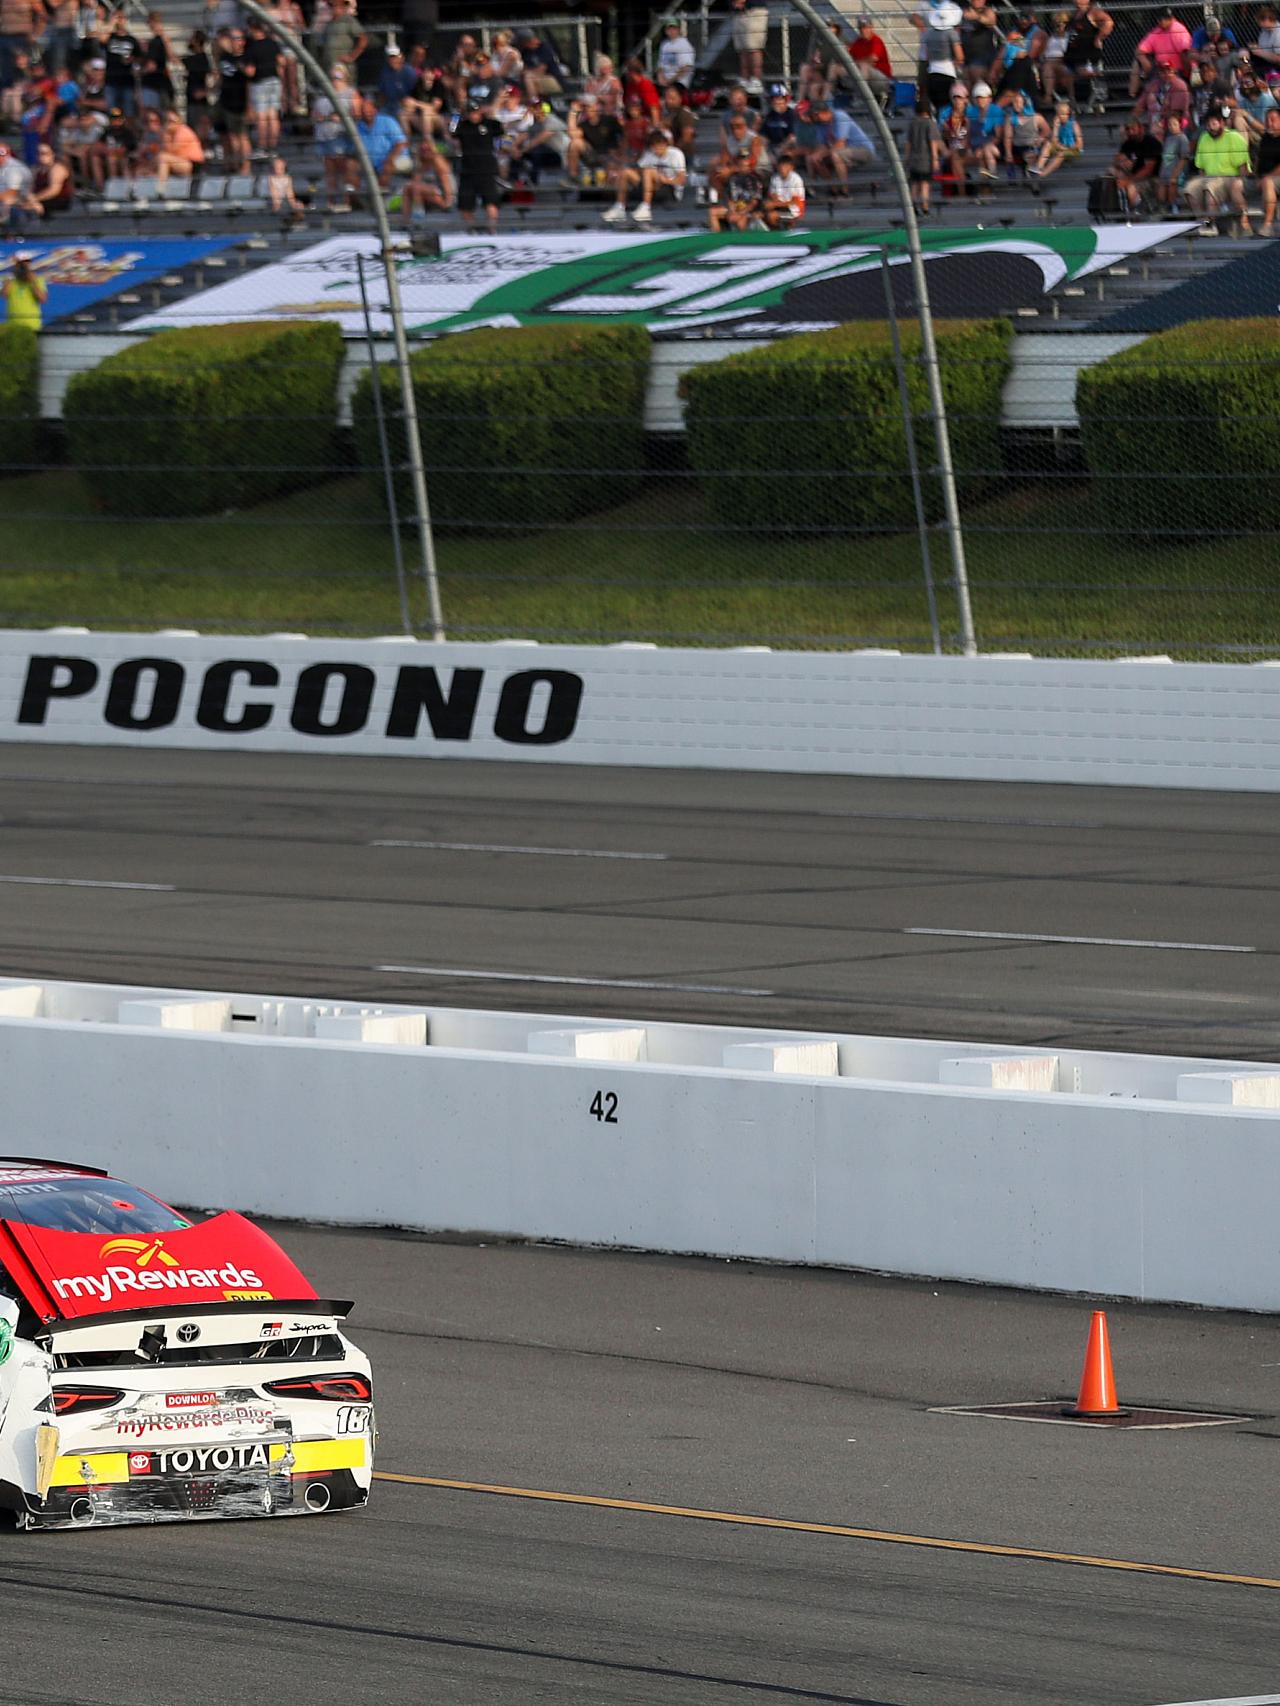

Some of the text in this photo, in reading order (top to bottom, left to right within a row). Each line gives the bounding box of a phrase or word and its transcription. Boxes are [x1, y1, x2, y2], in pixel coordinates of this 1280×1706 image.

[16, 655, 585, 745] POCONO
[589, 1090, 619, 1124] 42
[52, 1262, 263, 1301] myRewards
[260, 1323, 332, 1337] GR Supra
[337, 1406, 370, 1434] 18
[156, 1445, 270, 1473] TOYOTA
